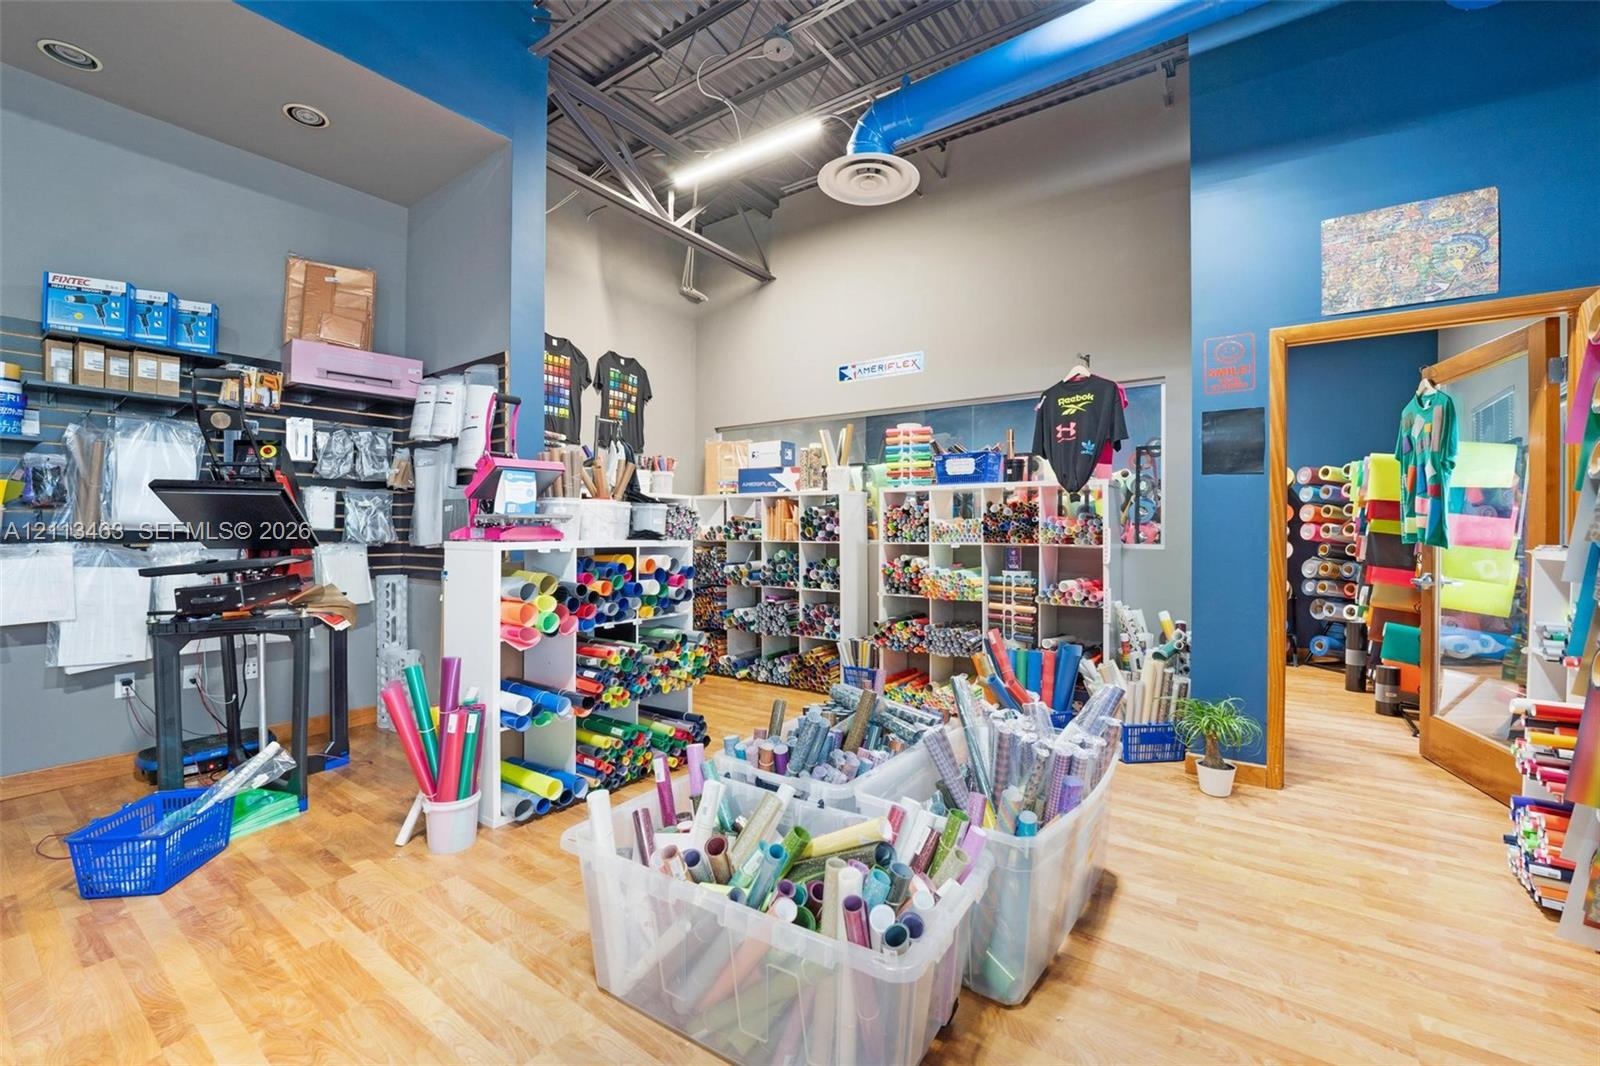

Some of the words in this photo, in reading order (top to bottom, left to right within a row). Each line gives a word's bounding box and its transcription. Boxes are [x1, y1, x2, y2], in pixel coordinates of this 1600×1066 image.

[52, 275, 91, 287] FIXTEC
[857, 359, 921, 375] AMERIFLEX
[1058, 393, 1094, 406] Reebok
